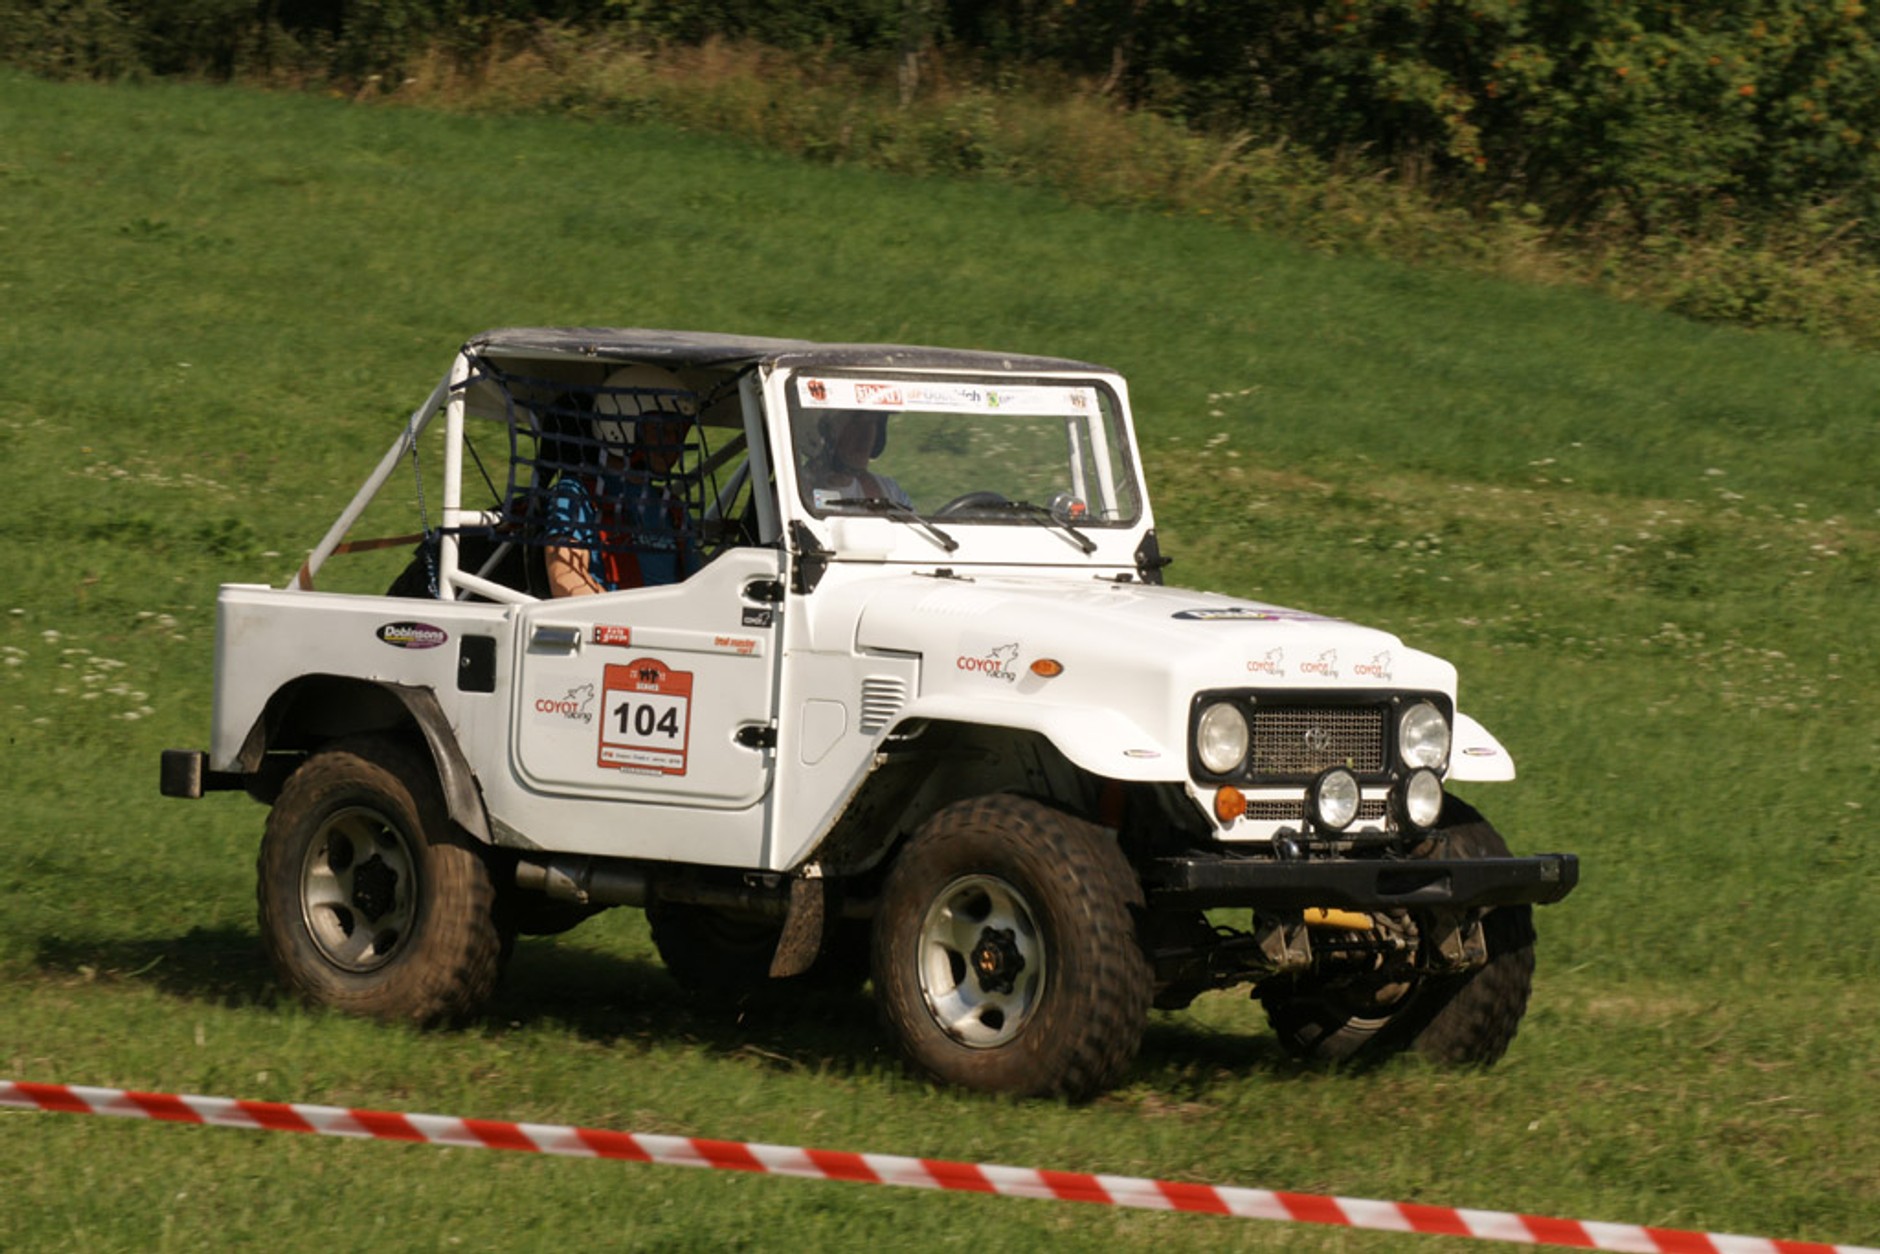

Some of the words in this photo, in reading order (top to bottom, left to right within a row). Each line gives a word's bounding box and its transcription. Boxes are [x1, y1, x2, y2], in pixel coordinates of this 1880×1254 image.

[384, 626, 444, 640] Dobinsons
[956, 655, 1001, 672] COYOT
[986, 669, 1016, 683] racing
[535, 698, 579, 714] COYOT
[564, 711, 593, 724] racing
[613, 701, 679, 739] 104
